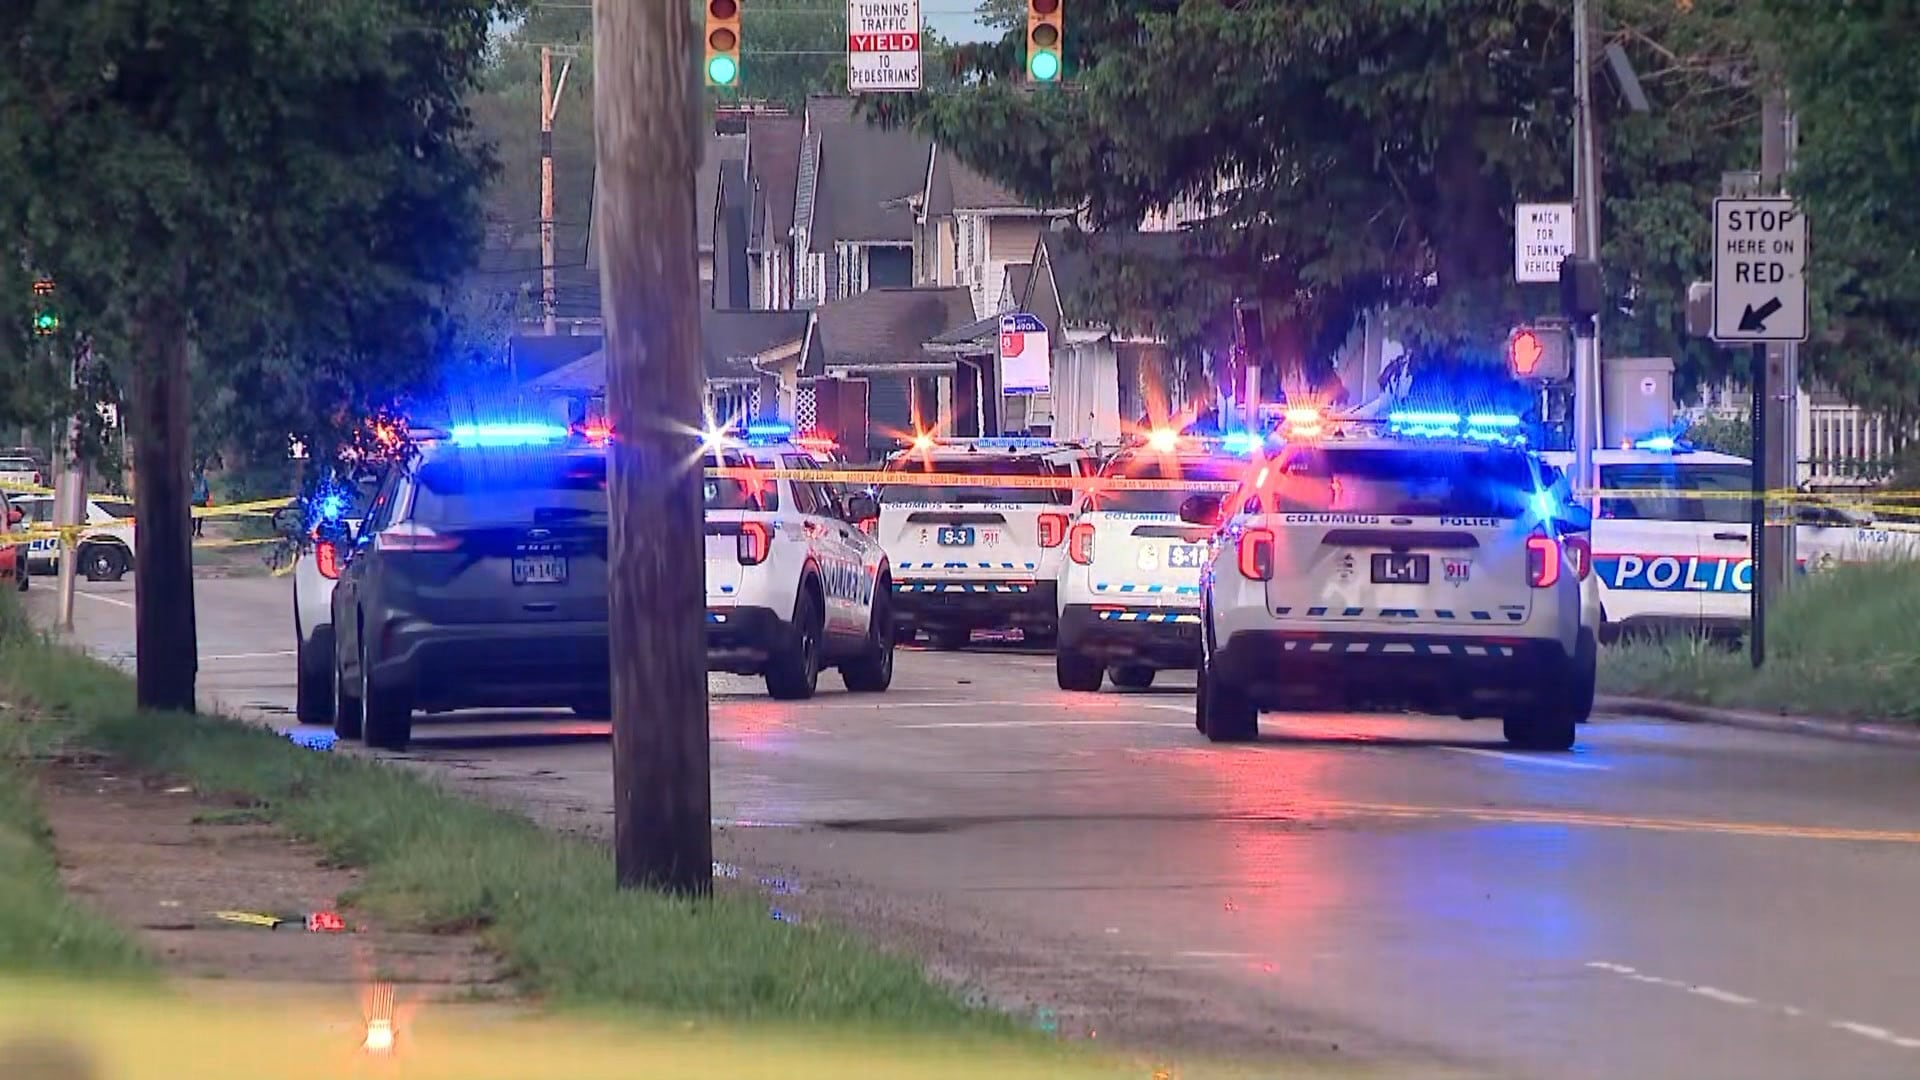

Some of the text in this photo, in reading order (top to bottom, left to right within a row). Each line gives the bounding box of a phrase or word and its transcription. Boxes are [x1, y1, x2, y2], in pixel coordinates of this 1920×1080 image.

[860, 3, 909, 17] TURNING
[862, 17, 907, 31] TRAFFIC
[855, 34, 914, 51] YIELD
[879, 55, 890, 69] TO
[852, 69, 917, 83] PEDESTRIANS
[1532, 212, 1560, 225] WATCH
[1728, 210, 1794, 232] STOP
[1537, 228, 1554, 241] FOR
[1526, 245, 1565, 257] TURNING
[1727, 240, 1794, 254] HERE ON
[1735, 262, 1784, 283] RED
[1286, 514, 1501, 528] COLUMBUS POLICE
[944, 531, 967, 545] S-3
[1385, 559, 1416, 579] L-1
[1446, 564, 1468, 577] 911
[1614, 555, 1753, 591] POLIC
